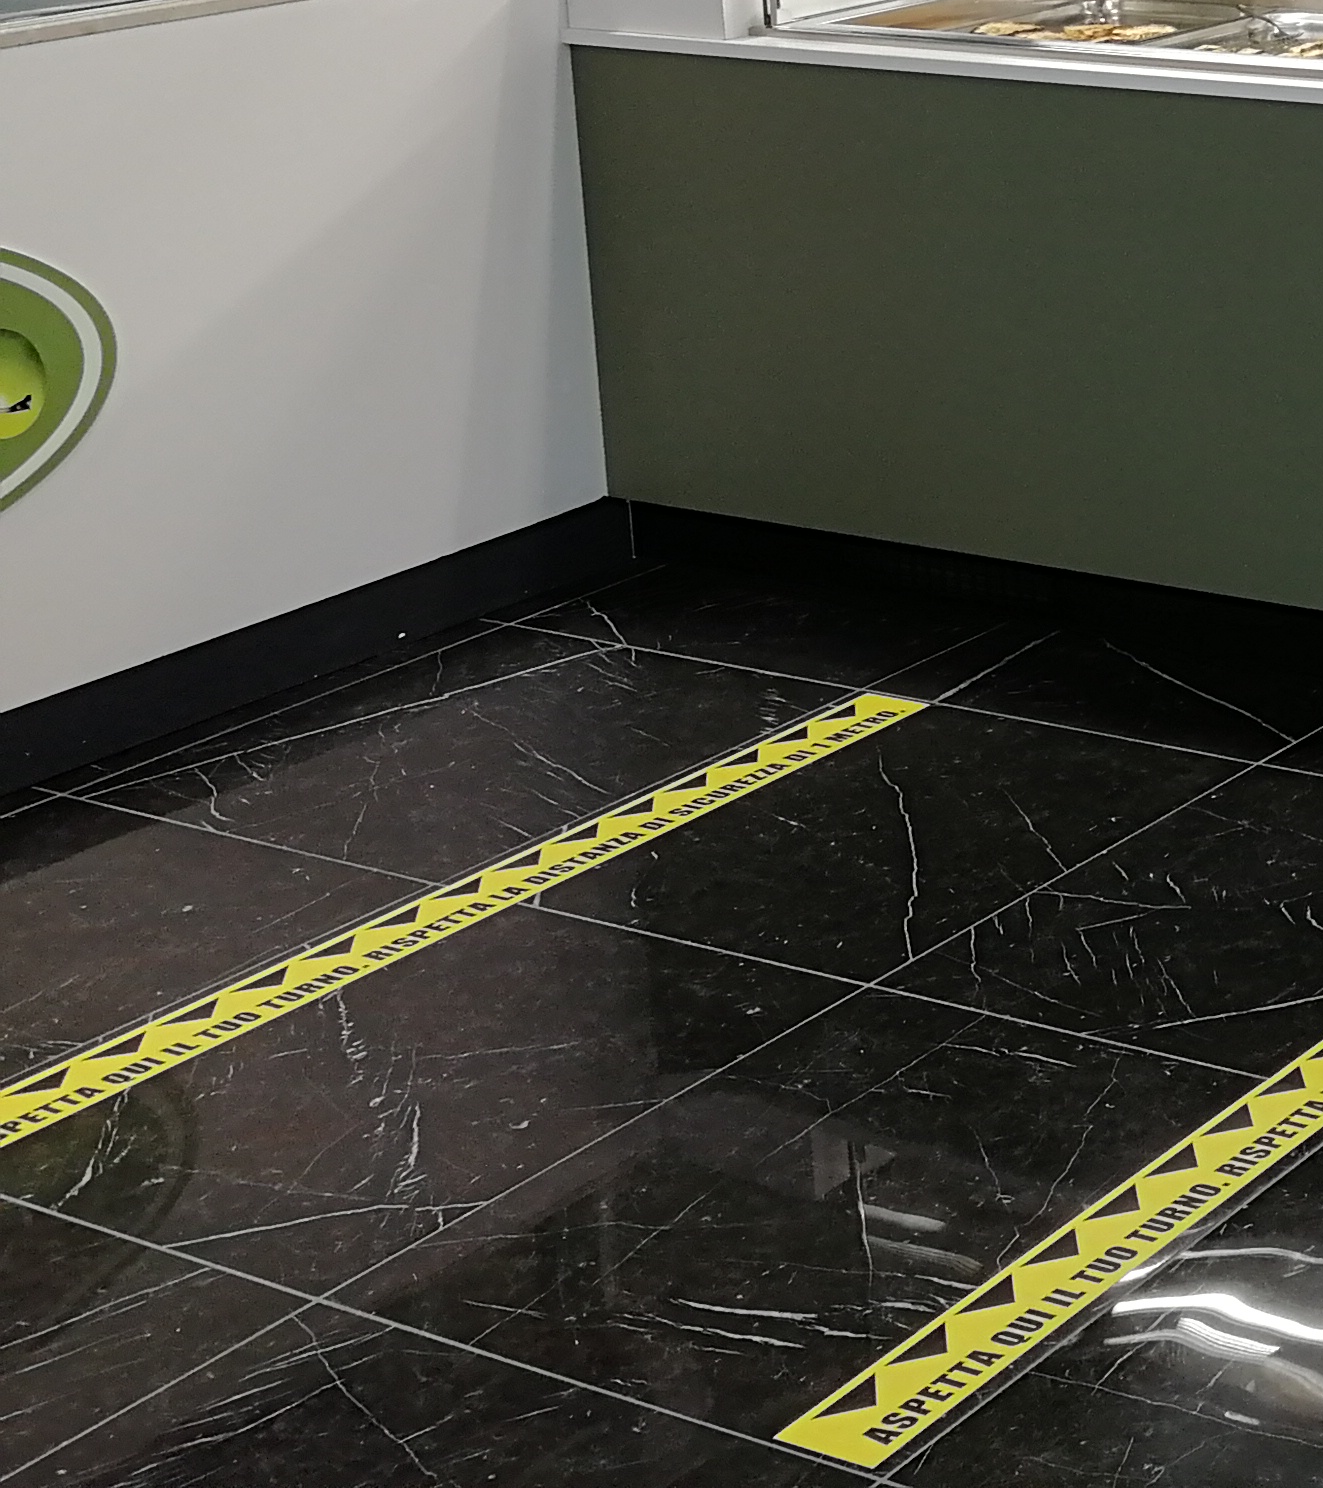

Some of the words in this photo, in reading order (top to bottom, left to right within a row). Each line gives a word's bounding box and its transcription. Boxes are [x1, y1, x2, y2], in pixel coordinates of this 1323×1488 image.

[101, 1056, 167, 1084] QUI
[161, 1042, 202, 1056] IL
[192, 1012, 262, 1039] TUO
[256, 964, 371, 1010] TURNO.
[362, 901, 498, 962] RISPETTA
[488, 886, 532, 902] LA
[522, 831, 647, 886] DISTANZA
[638, 816, 675, 831] DI
[669, 762, 792, 817] SICUREZZA
[782, 749, 818, 762] DI
[823, 709, 907, 743] METRO.
[862, 1350, 1005, 1446] ASPETTA
[990, 1308, 1057, 1347] QUI
[1041, 1288, 1087, 1308] IL
[1069, 1245, 1139, 1284] TUO
[1123, 1182, 1231, 1243] TURNO.
